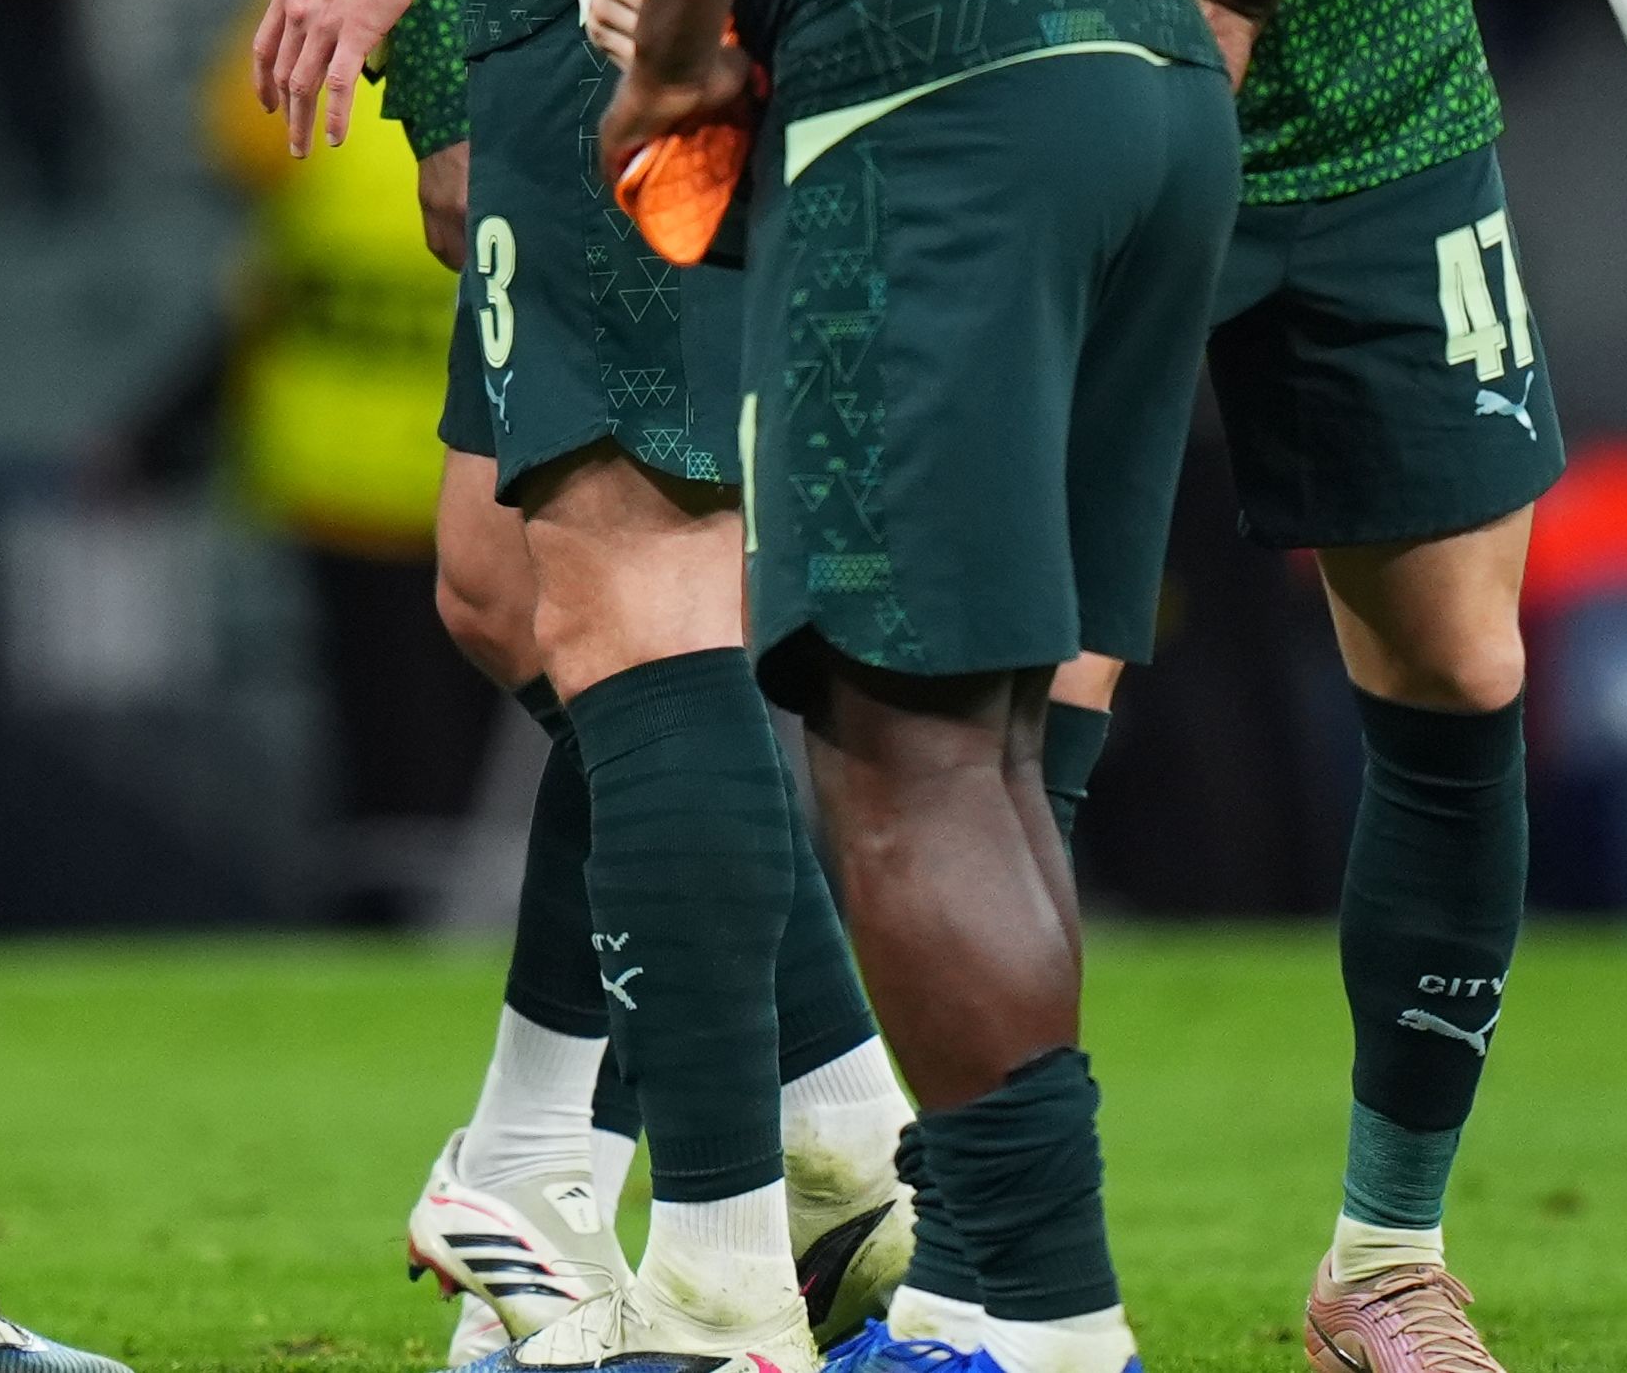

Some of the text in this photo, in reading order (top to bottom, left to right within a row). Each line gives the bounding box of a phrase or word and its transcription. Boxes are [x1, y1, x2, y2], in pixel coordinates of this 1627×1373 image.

[476, 215, 517, 369] 3
[1434, 208, 1535, 383] 47
[591, 931, 630, 952] ITY
[1418, 969, 1509, 998] CITY
